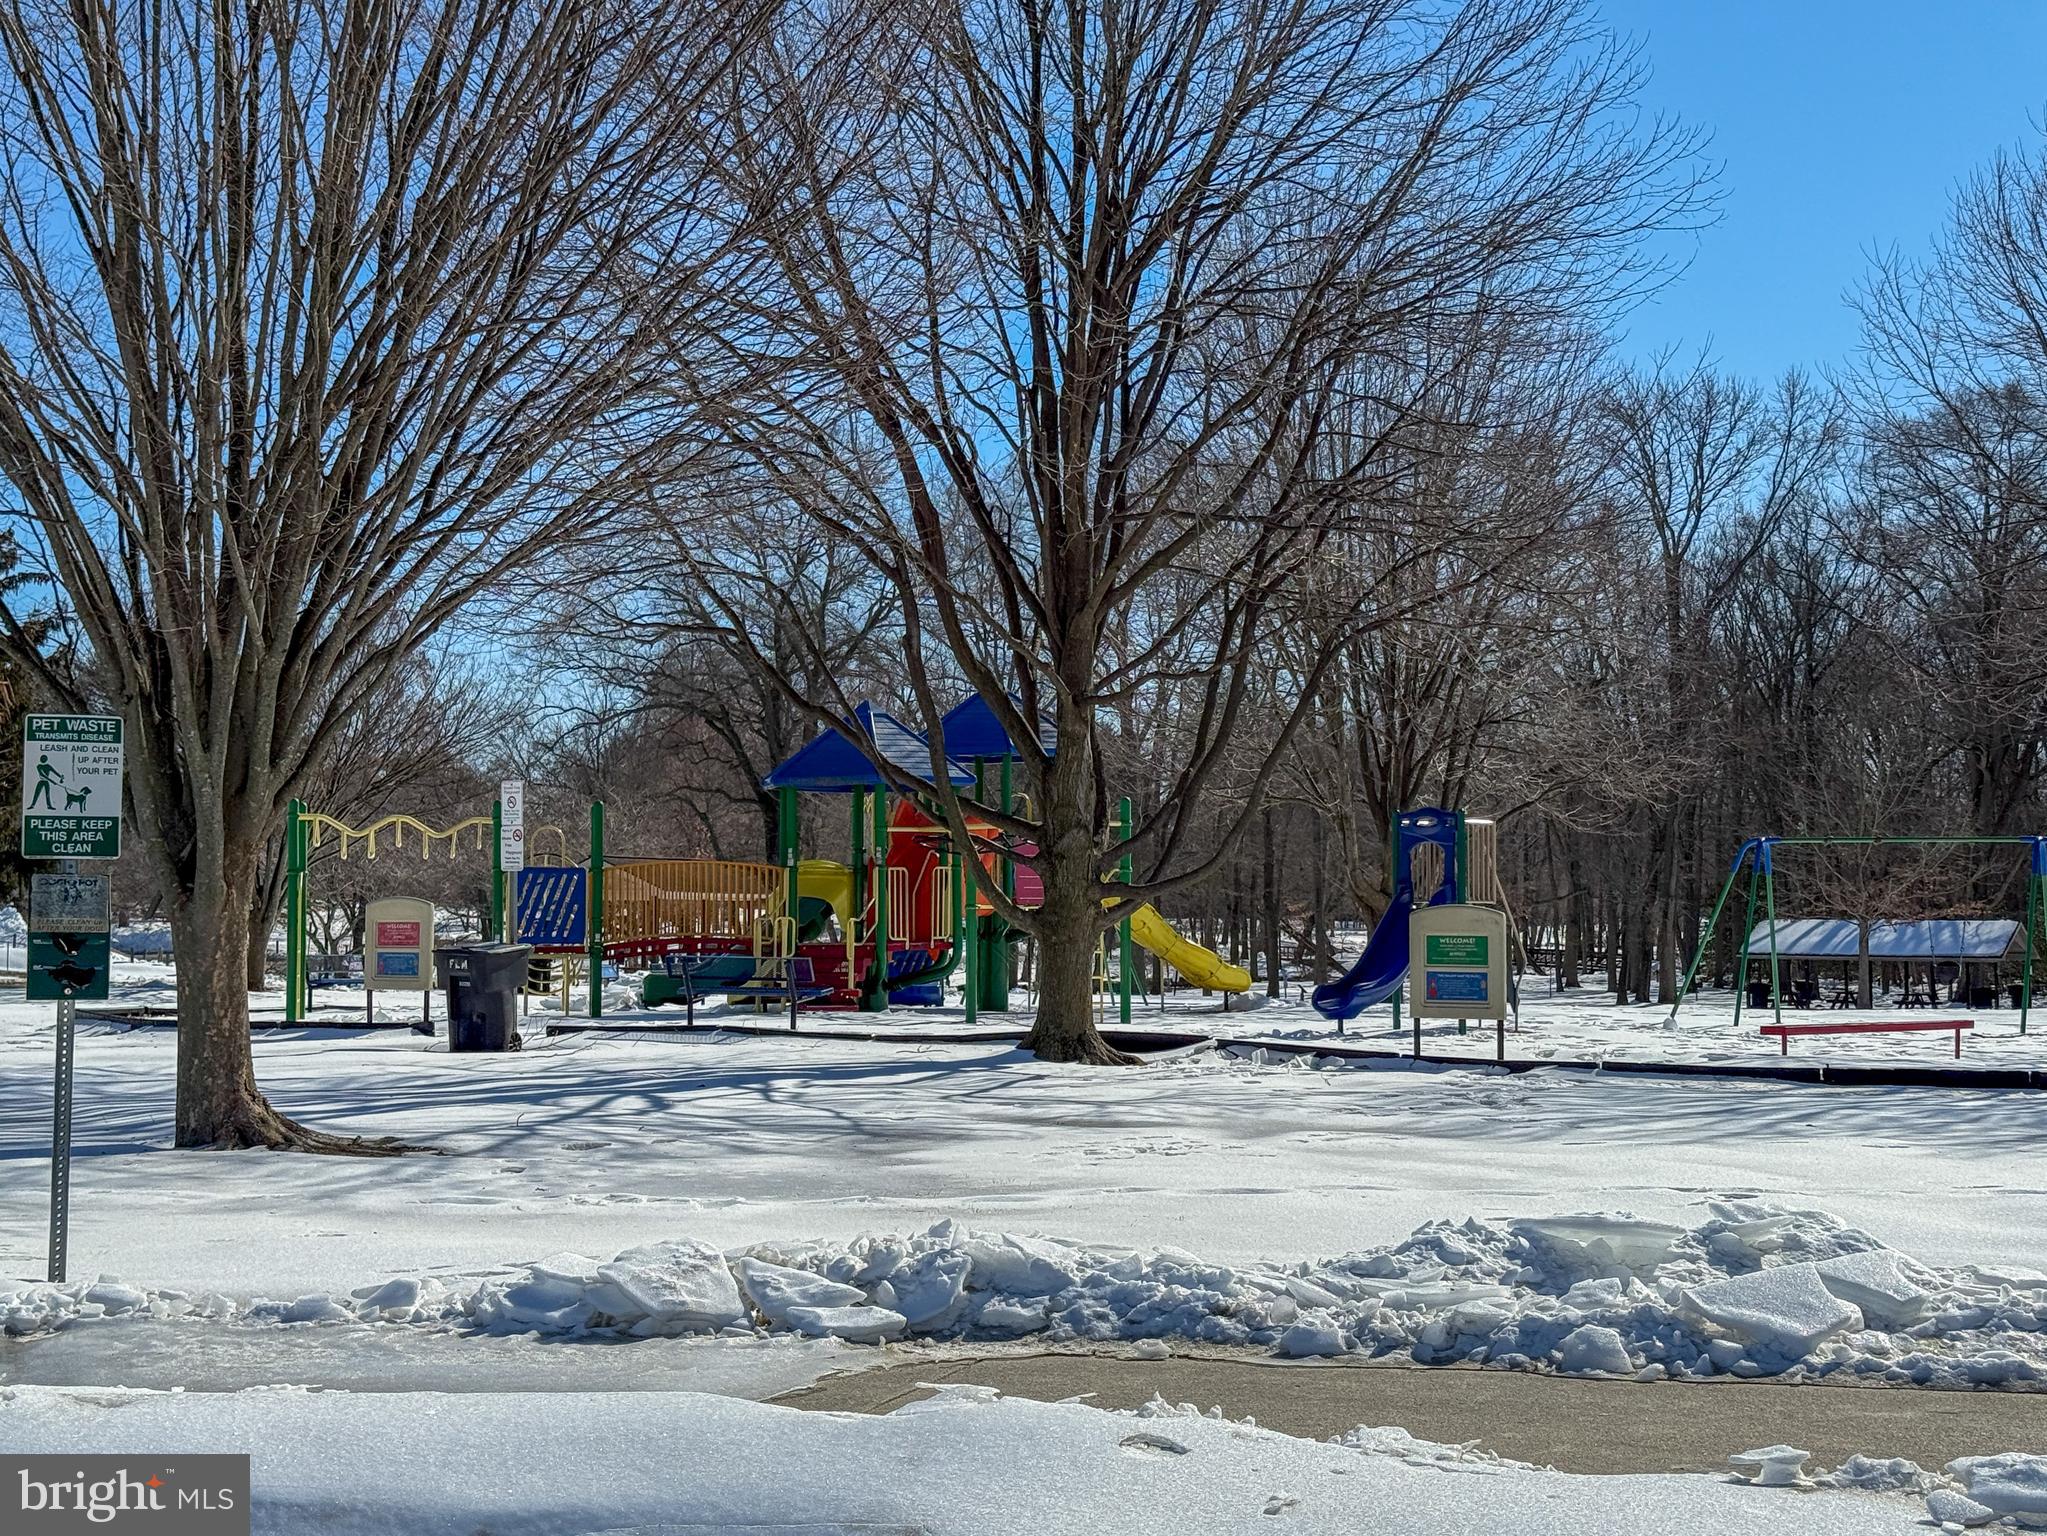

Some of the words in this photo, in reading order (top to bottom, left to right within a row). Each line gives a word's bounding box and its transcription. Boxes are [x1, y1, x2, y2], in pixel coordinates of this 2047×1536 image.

[32, 719, 60, 731] PET
[66, 719, 116, 733] WASTE
[35, 732, 78, 741] TRANSMITS
[81, 733, 114, 742] DISEASE
[40, 744, 68, 752] LEASH
[71, 745, 88, 753] AND
[91, 745, 119, 754] CLEAN
[92, 756, 119, 765] AFTER
[77, 767, 99, 775] YOUR
[103, 768, 119, 776] PET
[30, 819, 77, 830] PLEASE
[81, 820, 113, 830] KEEP
[39, 831, 67, 841] THIS
[71, 832, 104, 841] AREA
[51, 843, 92, 853] CLEAN
